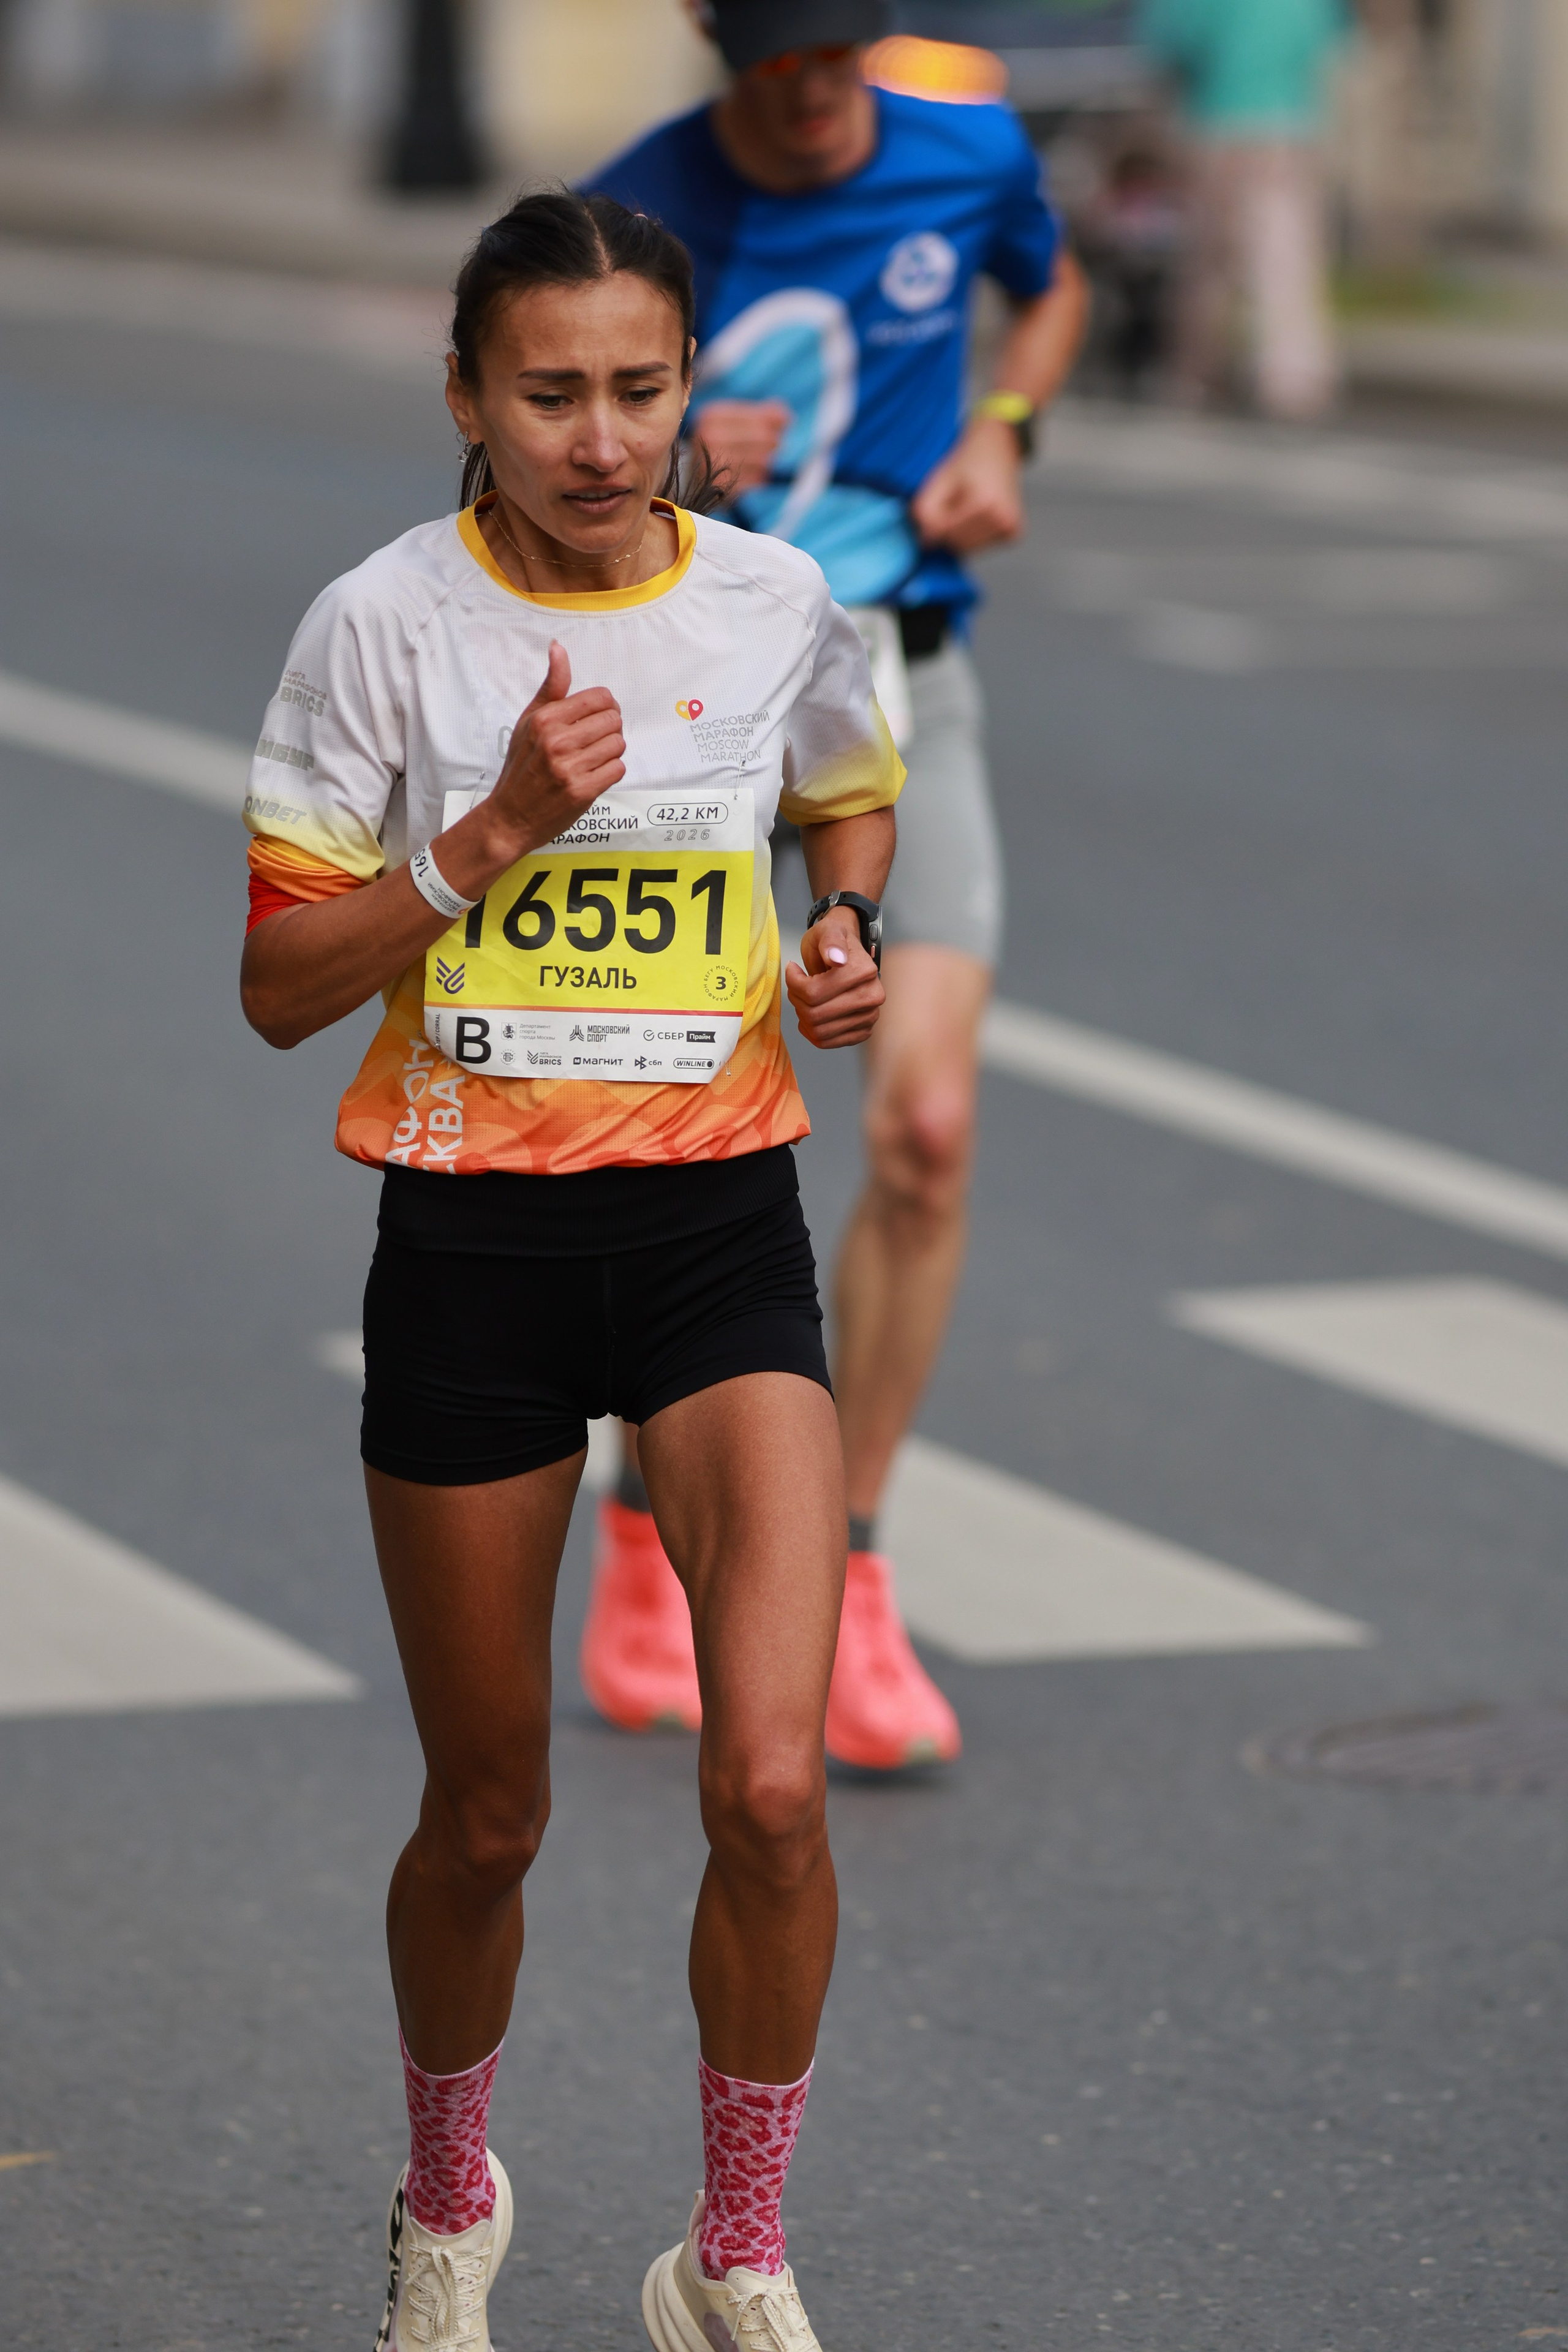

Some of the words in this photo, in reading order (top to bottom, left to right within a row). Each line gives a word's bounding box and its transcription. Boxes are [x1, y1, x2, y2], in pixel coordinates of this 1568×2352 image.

[280, 687, 325, 717] BRICS
[690, 710, 770, 733] МОСКОВСКИЙ
[693, 726, 753, 742] МАРАФОН
[698, 739, 748, 752] MOSCOW
[701, 749, 761, 763] MARATHON
[657, 807, 689, 821] 42,2
[696, 807, 718, 819] КМ
[664, 829, 710, 841] 2026
[539, 965, 637, 989] ГУЗАЛЬ
[704, 968, 714, 981] БЕГУ
[716, 965, 739, 997] МОСКОВСКИЙ
[715, 976, 726, 990] 3
[703, 984, 728, 1001] МАРАФОН
[587, 1024, 630, 1034] МОСКОВСКИЙ
[423, 1075, 466, 1174] КВА
